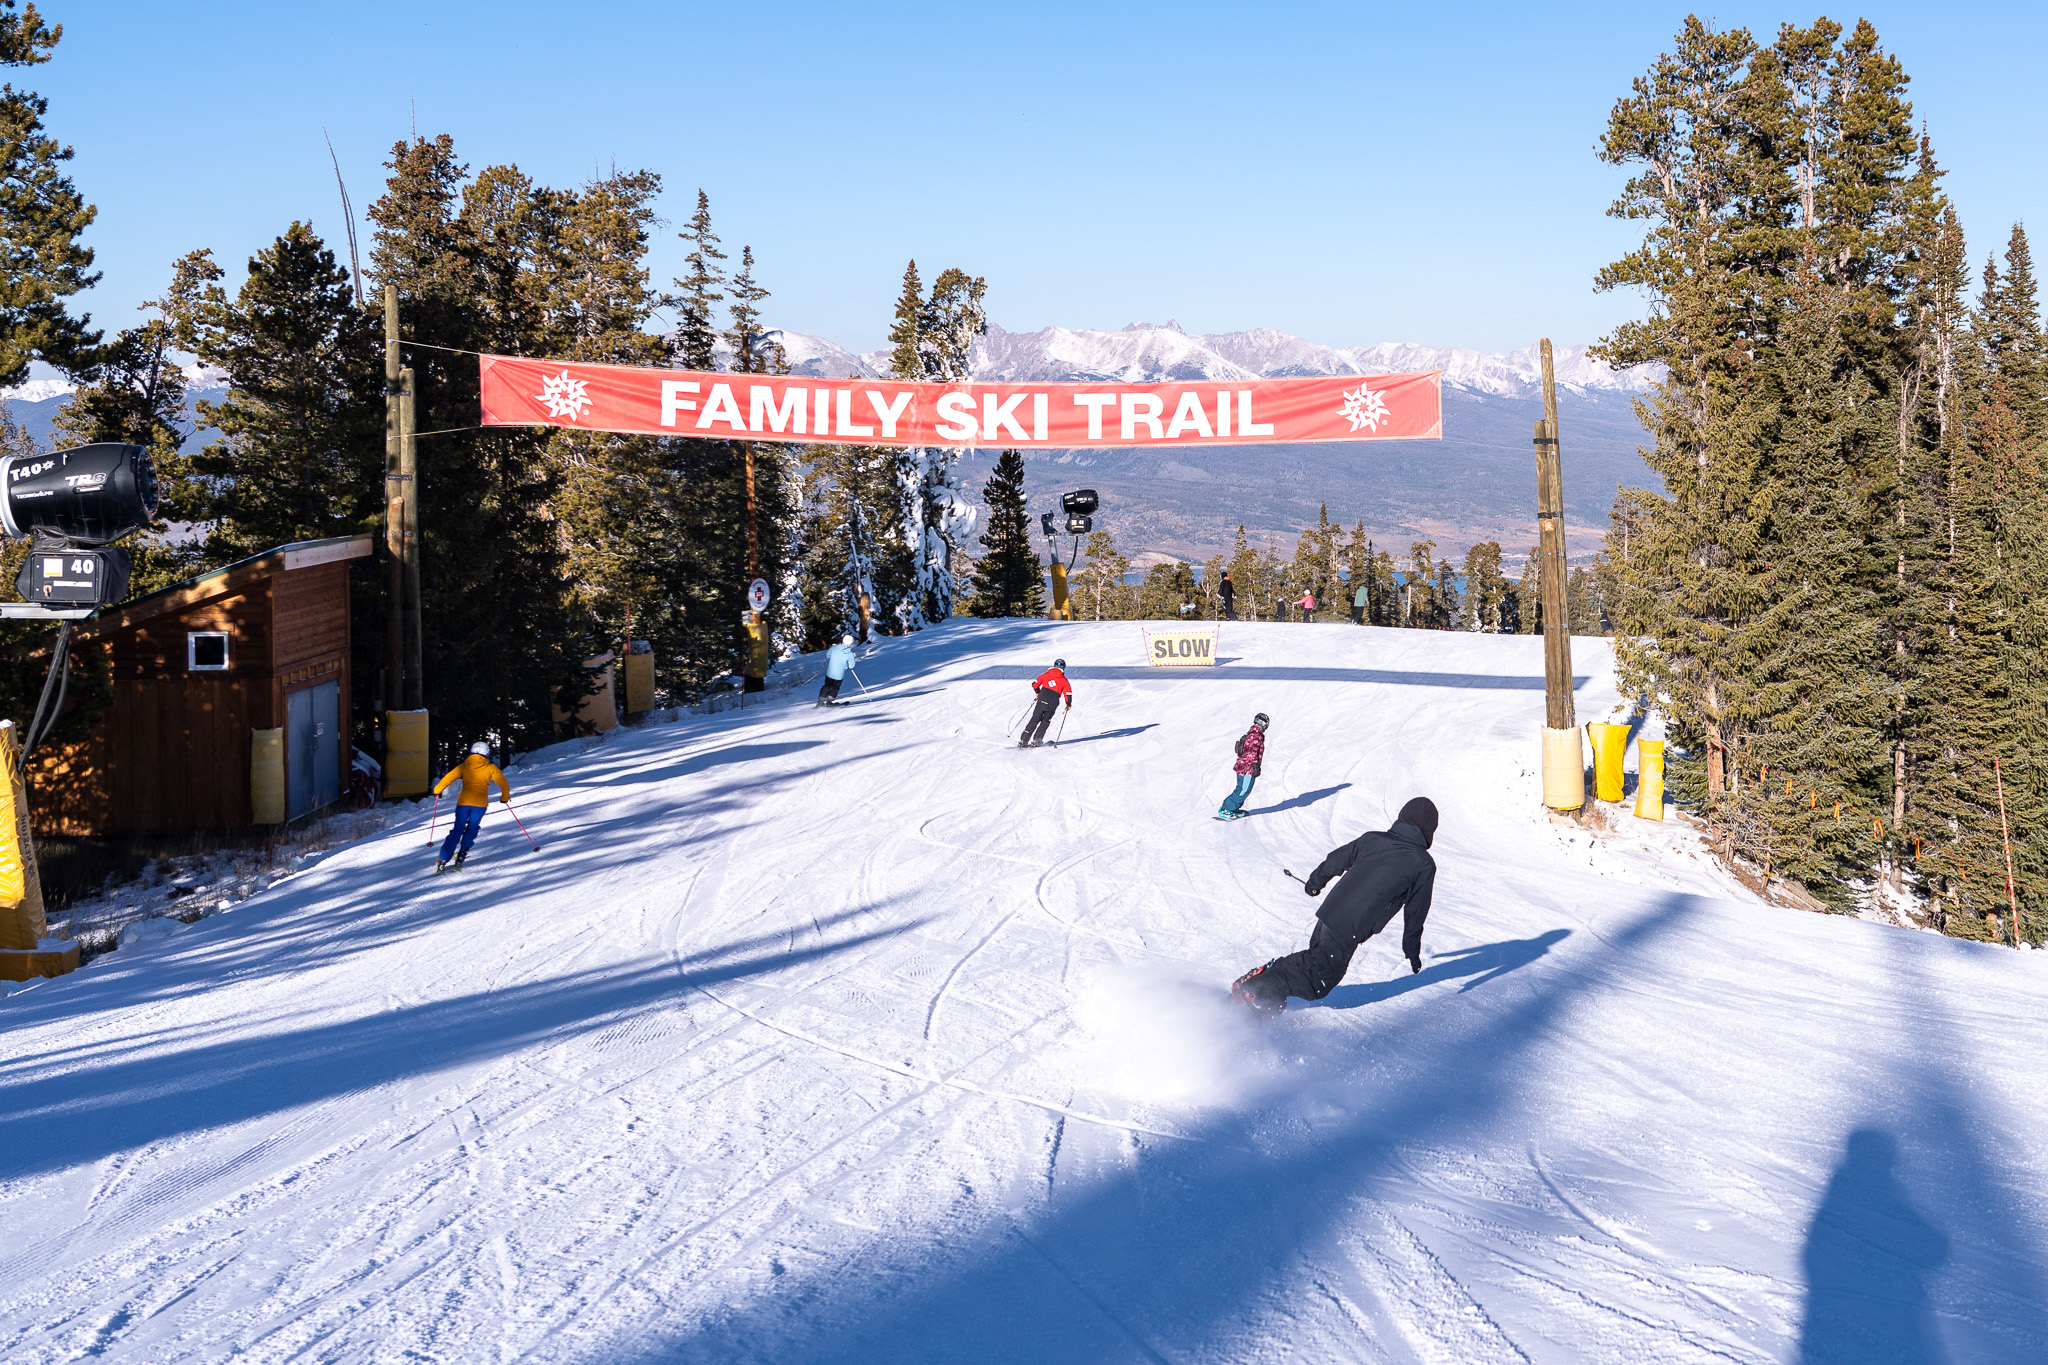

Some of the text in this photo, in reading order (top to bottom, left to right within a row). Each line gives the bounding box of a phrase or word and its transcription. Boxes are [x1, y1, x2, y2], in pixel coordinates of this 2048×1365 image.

[661, 379, 1274, 441] FAMILY SKI TRAIL
[10, 463, 41, 481] T40
[65, 472, 107, 487] TR8
[71, 559, 94, 574] 40
[1154, 639, 1211, 658] SLOW
[20, 813, 33, 861] KEYSTONE
